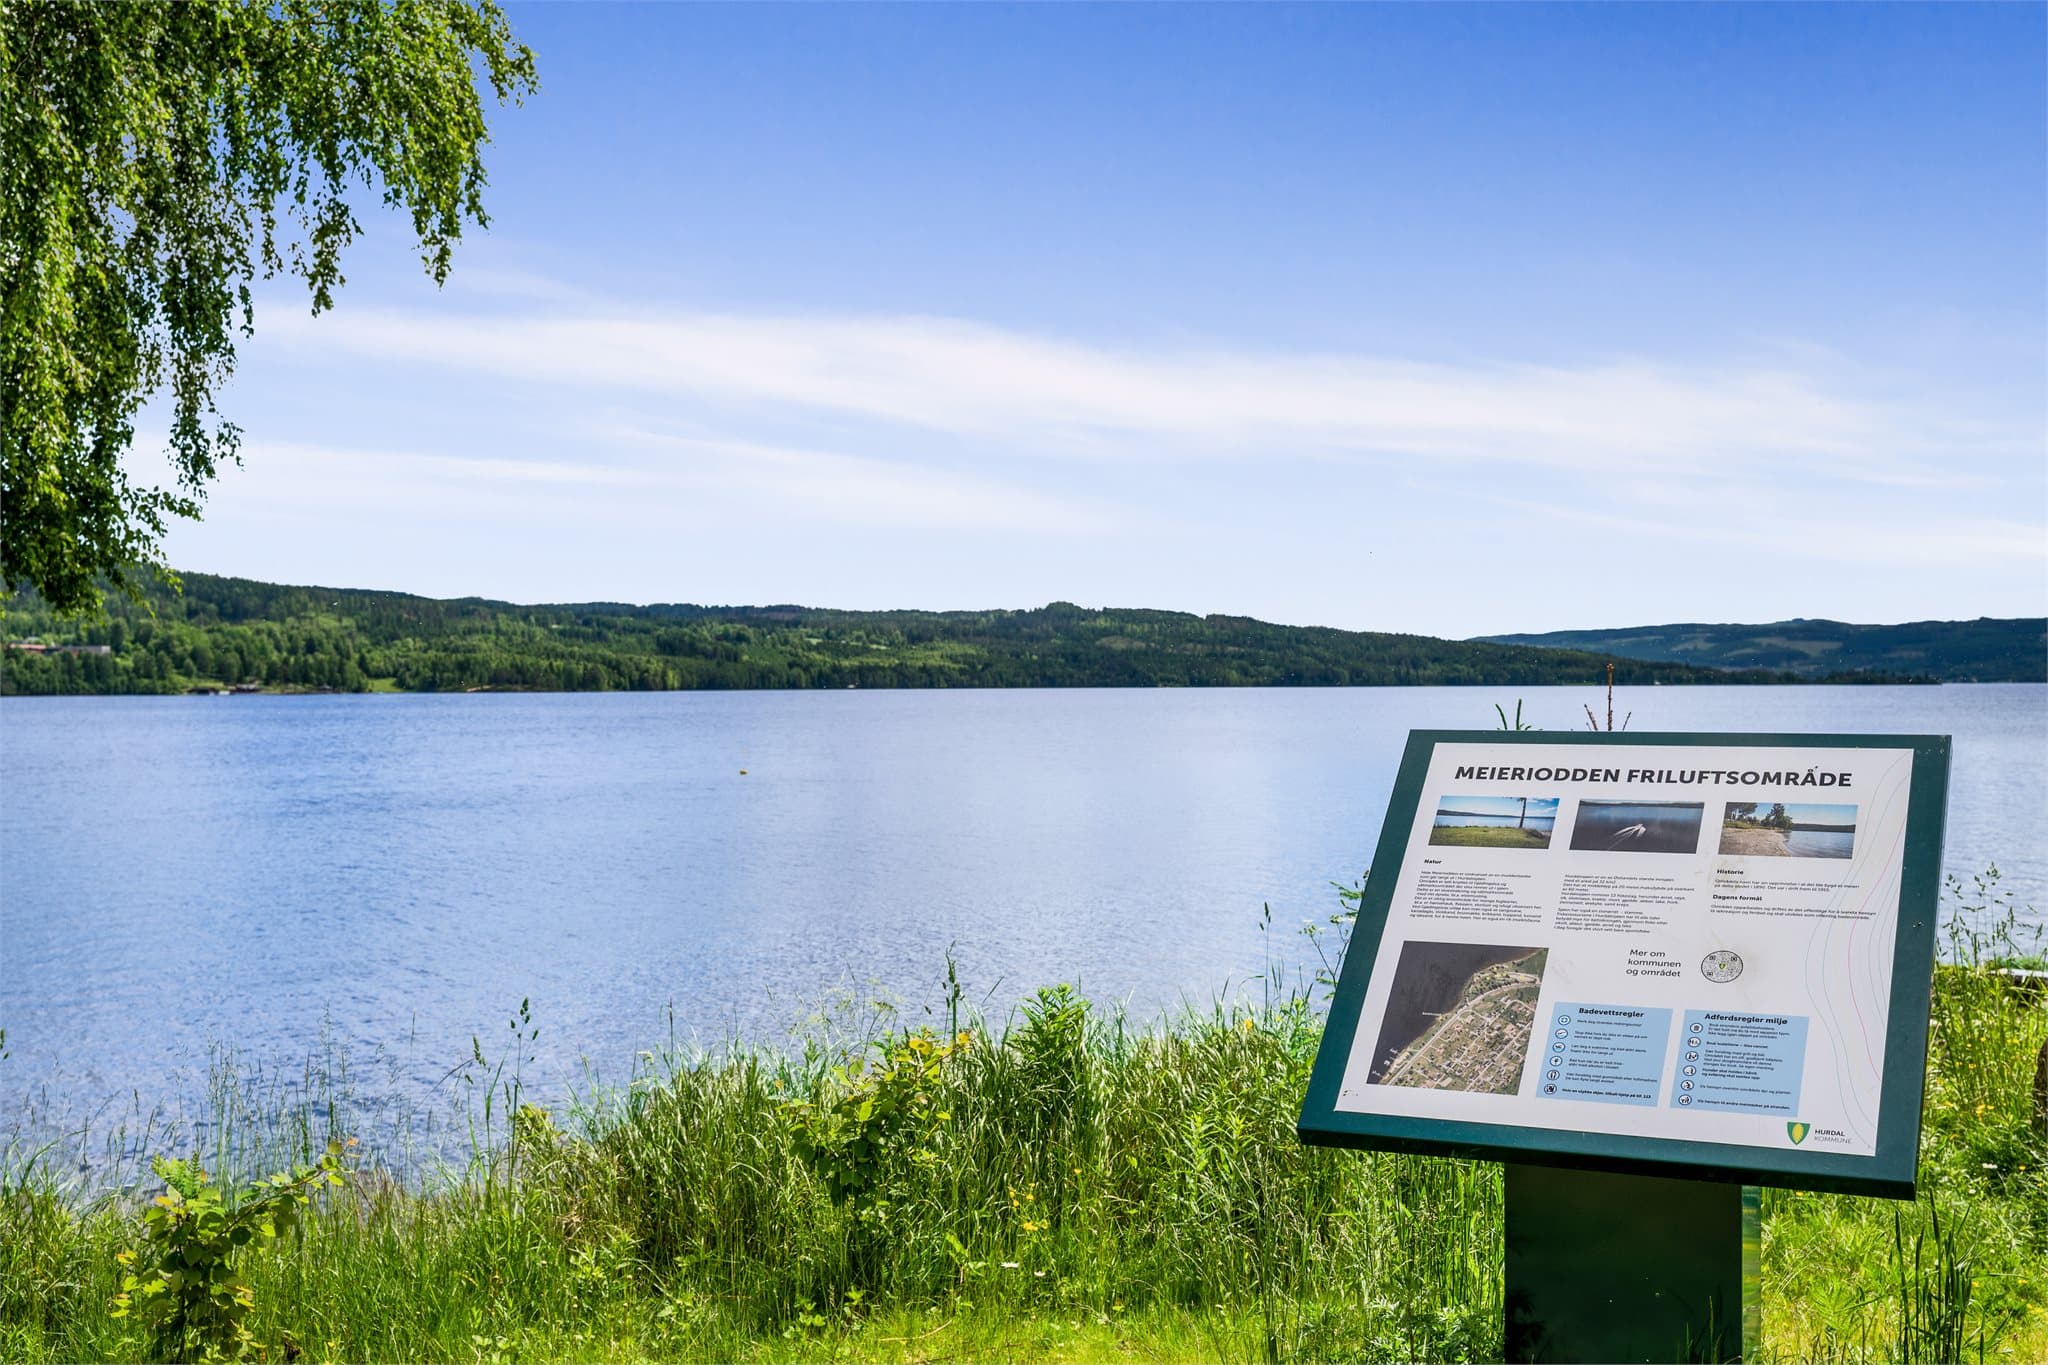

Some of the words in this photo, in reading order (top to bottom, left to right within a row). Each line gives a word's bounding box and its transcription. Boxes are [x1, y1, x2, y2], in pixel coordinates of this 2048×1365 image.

[1454, 766, 1620, 783] MEIERIODDEN
[1626, 768, 1853, 787] FRILUFTSOMRÅDE
[1629, 949, 1648, 957] Mer
[1628, 958, 1682, 968] kommunen
[1625, 968, 1638, 976] og
[1640, 968, 1681, 977] området
[1578, 1007, 1645, 1018] Badevettsregler
[1704, 1013, 1764, 1024] Adferdsregler
[1765, 1017, 1788, 1026] miljø
[1814, 1129, 1845, 1137] HURDAL
[1813, 1136, 1852, 1144] KOMMUNE
